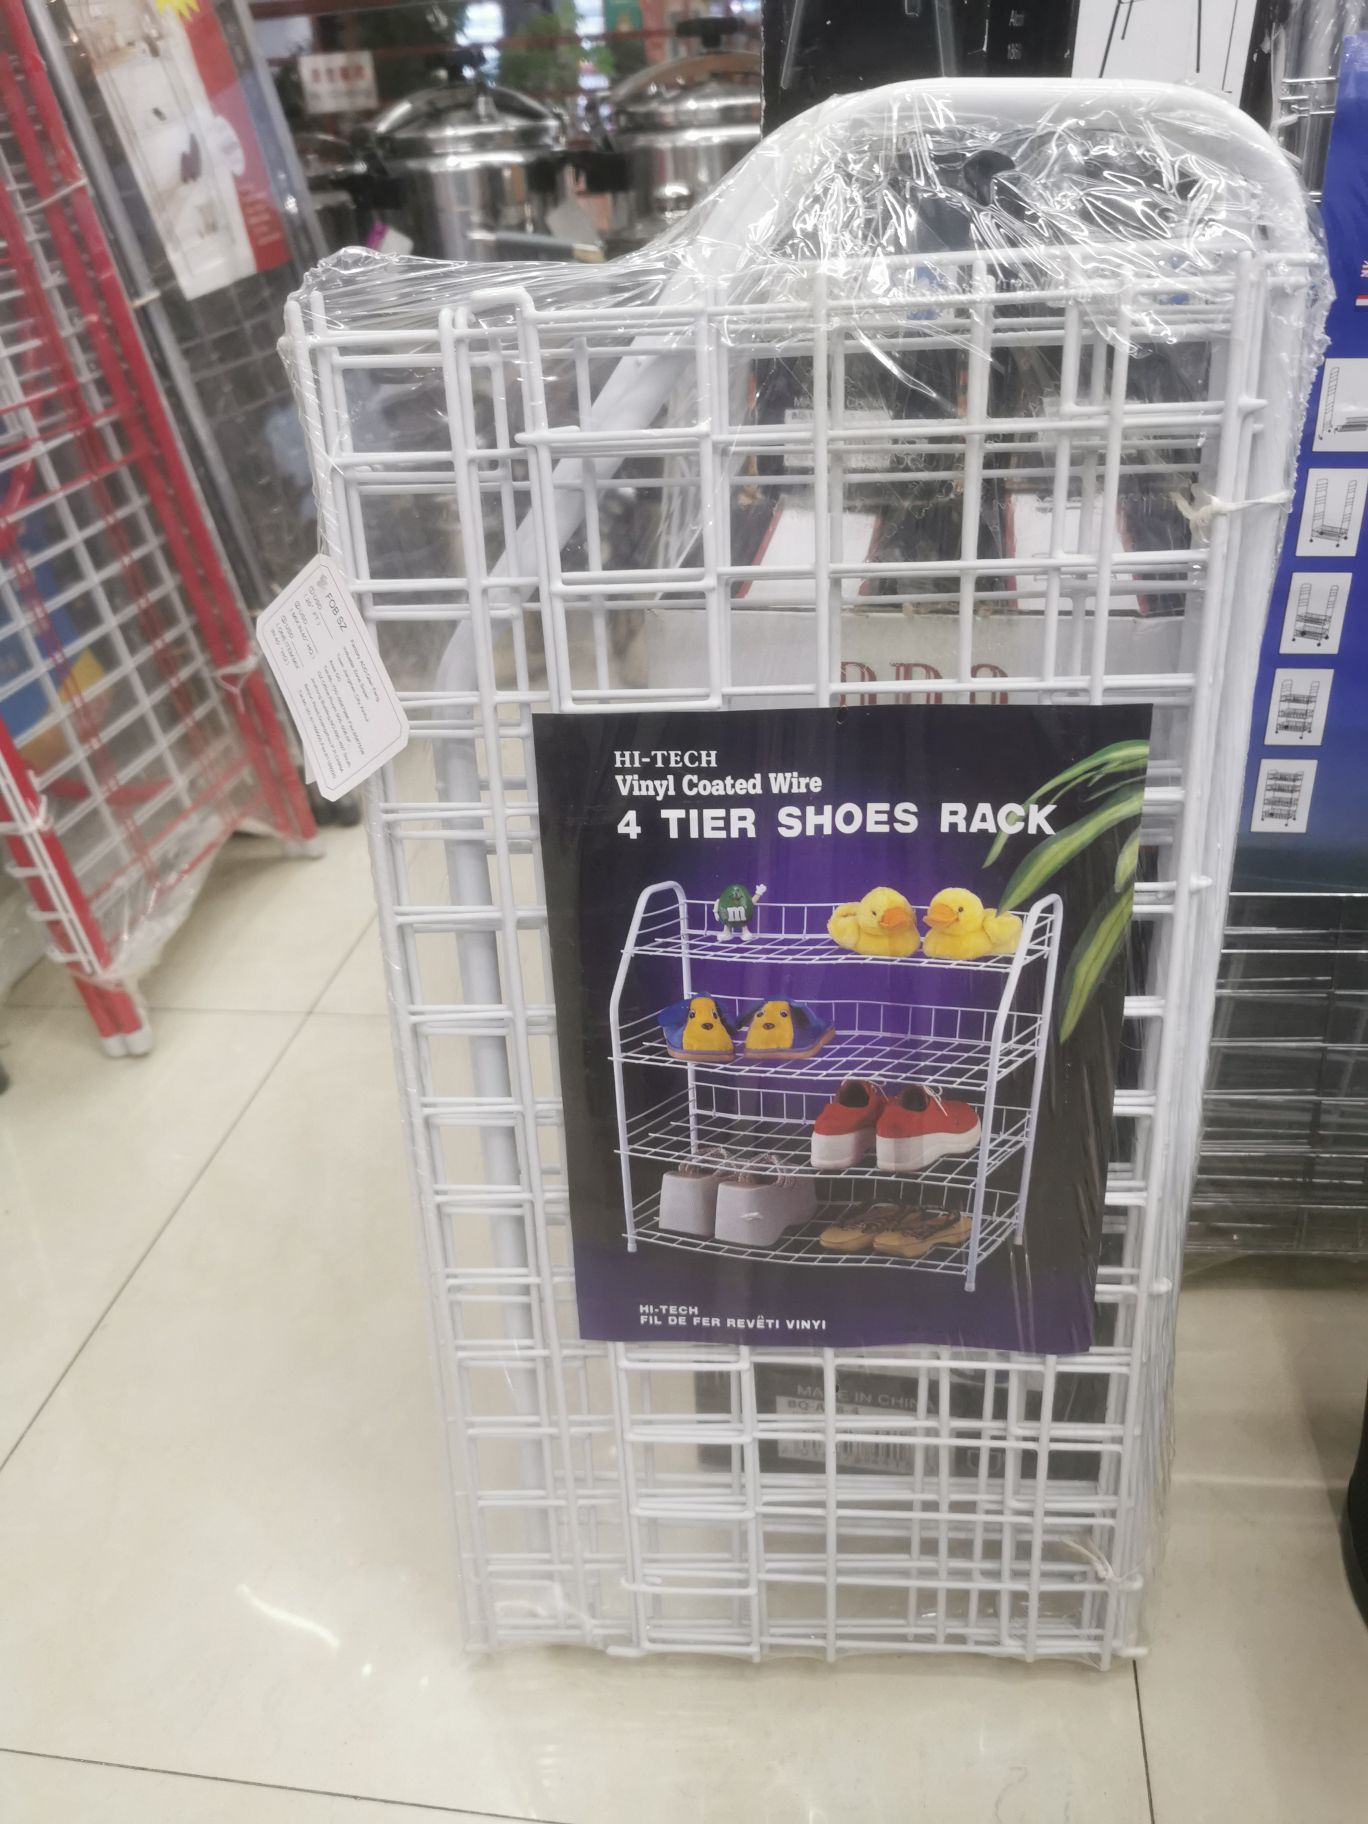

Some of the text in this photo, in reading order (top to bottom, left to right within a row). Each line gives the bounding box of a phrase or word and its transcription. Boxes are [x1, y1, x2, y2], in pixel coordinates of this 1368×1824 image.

[324, 593, 347, 631] FOB SZ
[614, 750, 718, 768] HI-TECH
[615, 771, 823, 801] Vinyl Coated Wire
[617, 802, 1057, 839] 4 TIER SHOES RACK
[639, 1304, 699, 1316] HI-TECH
[640, 1315, 662, 1326] FIL
[668, 1315, 687, 1326] DE
[692, 1316, 721, 1328] FER
[726, 1313, 780, 1330] REVÊTI
[855, 1391, 872, 1403] IN
